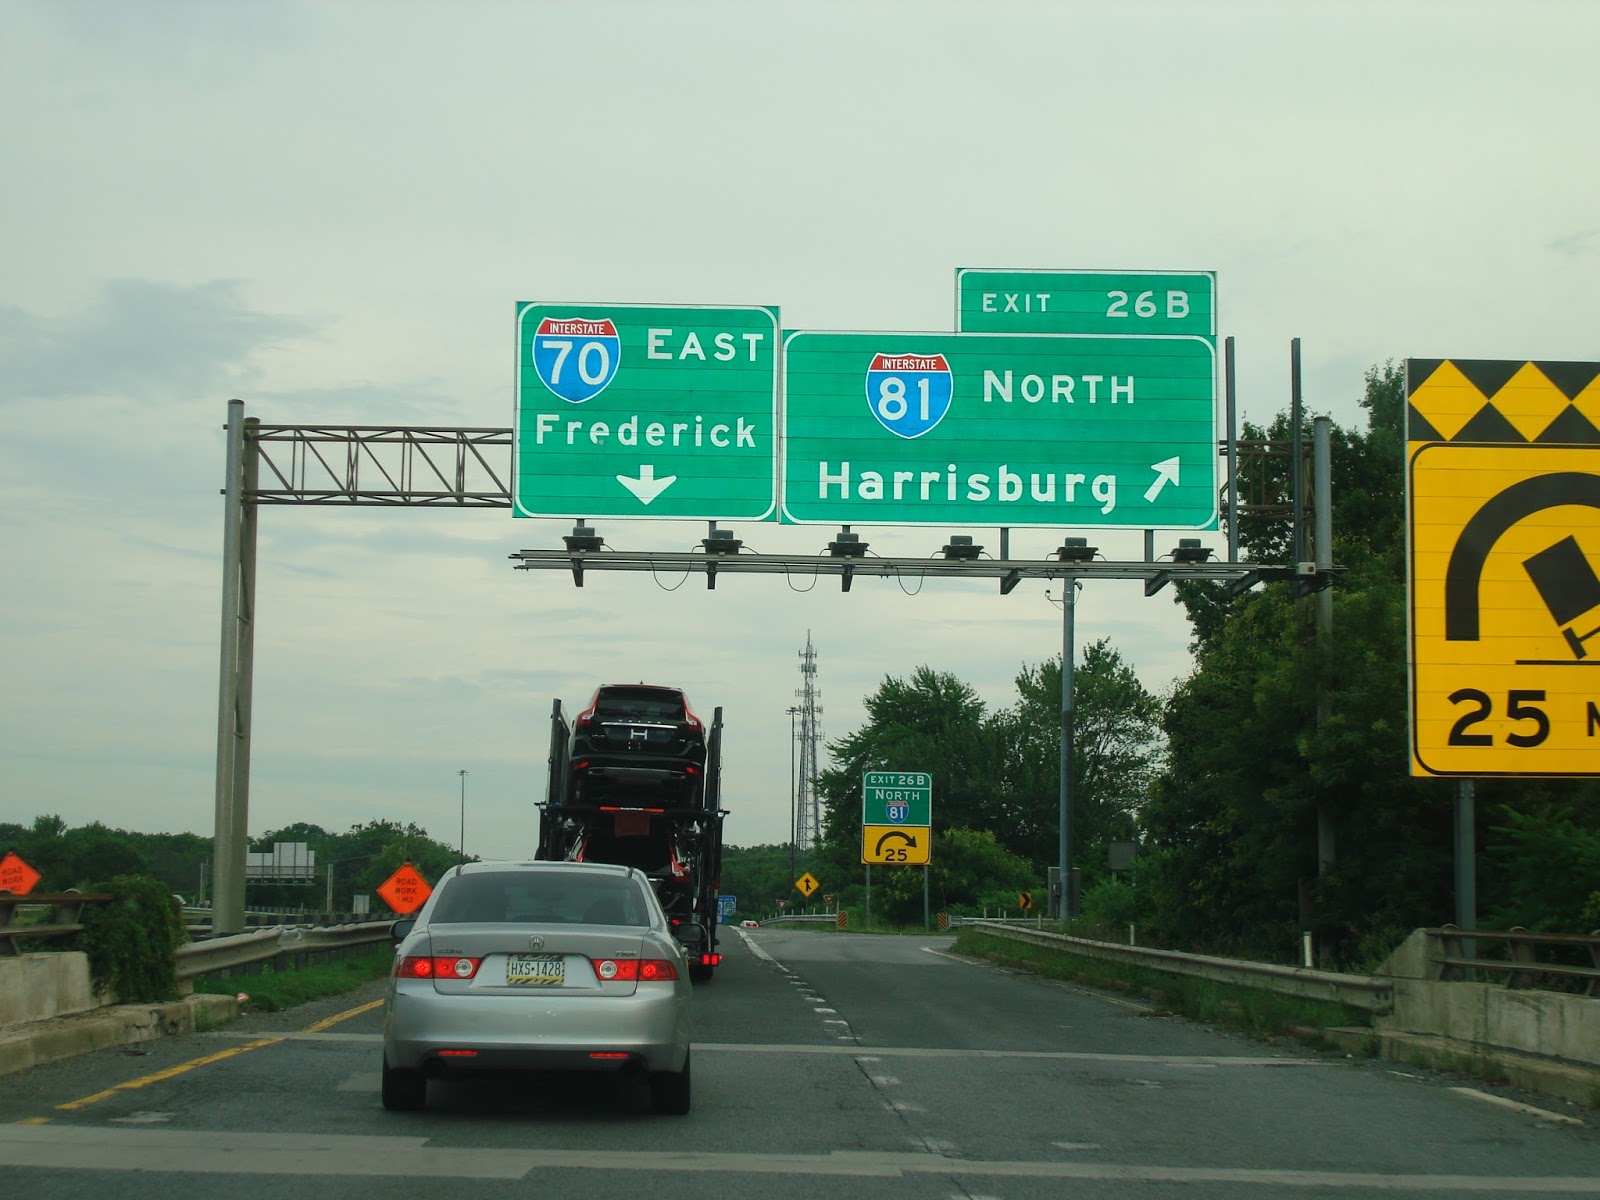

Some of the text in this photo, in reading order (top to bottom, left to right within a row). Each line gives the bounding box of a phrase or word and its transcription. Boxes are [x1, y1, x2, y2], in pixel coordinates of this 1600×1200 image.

[982, 293, 1051, 313] EXIT
[549, 323, 605, 335] INTERSTATE
[647, 328, 764, 362] EAST
[542, 340, 610, 386] 70
[882, 358, 937, 371] INTERSTATE
[983, 369, 1135, 404] NORTH
[878, 376, 930, 421] 81
[536, 414, 756, 448] Frederick
[818, 461, 1117, 515] Harrisburg
[1447, 688, 1550, 748] 25
[870, 775, 895, 784] EXIT
[875, 789, 920, 801] NORTH
[889, 806, 904, 819] 81
[885, 848, 908, 862] 25
[2, 866, 23, 876] ROAD
[2, 875, 24, 885] WORK
[395, 877, 418, 886] ROAD
[394, 887, 418, 896] WORK
